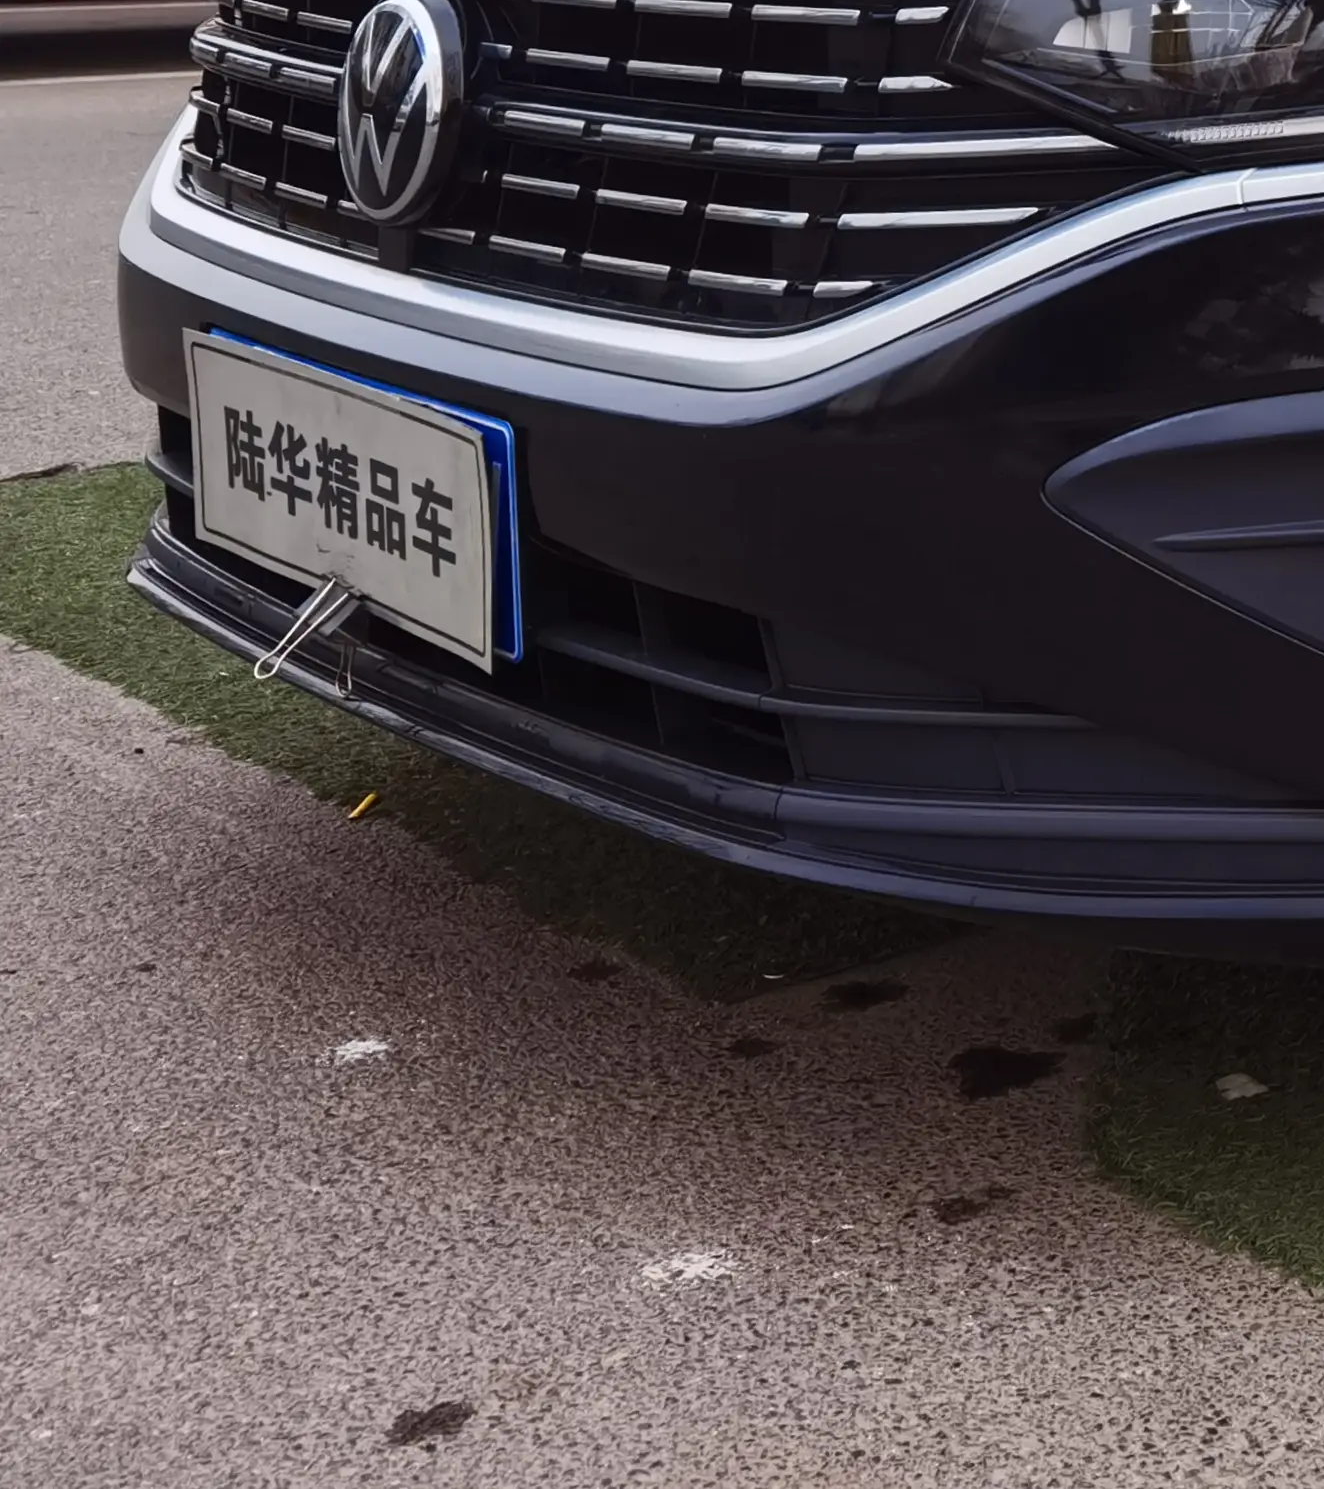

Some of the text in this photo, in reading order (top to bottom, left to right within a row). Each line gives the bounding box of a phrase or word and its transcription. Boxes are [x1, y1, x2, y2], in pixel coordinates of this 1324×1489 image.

[223, 405, 457, 578] 陆华精品车
